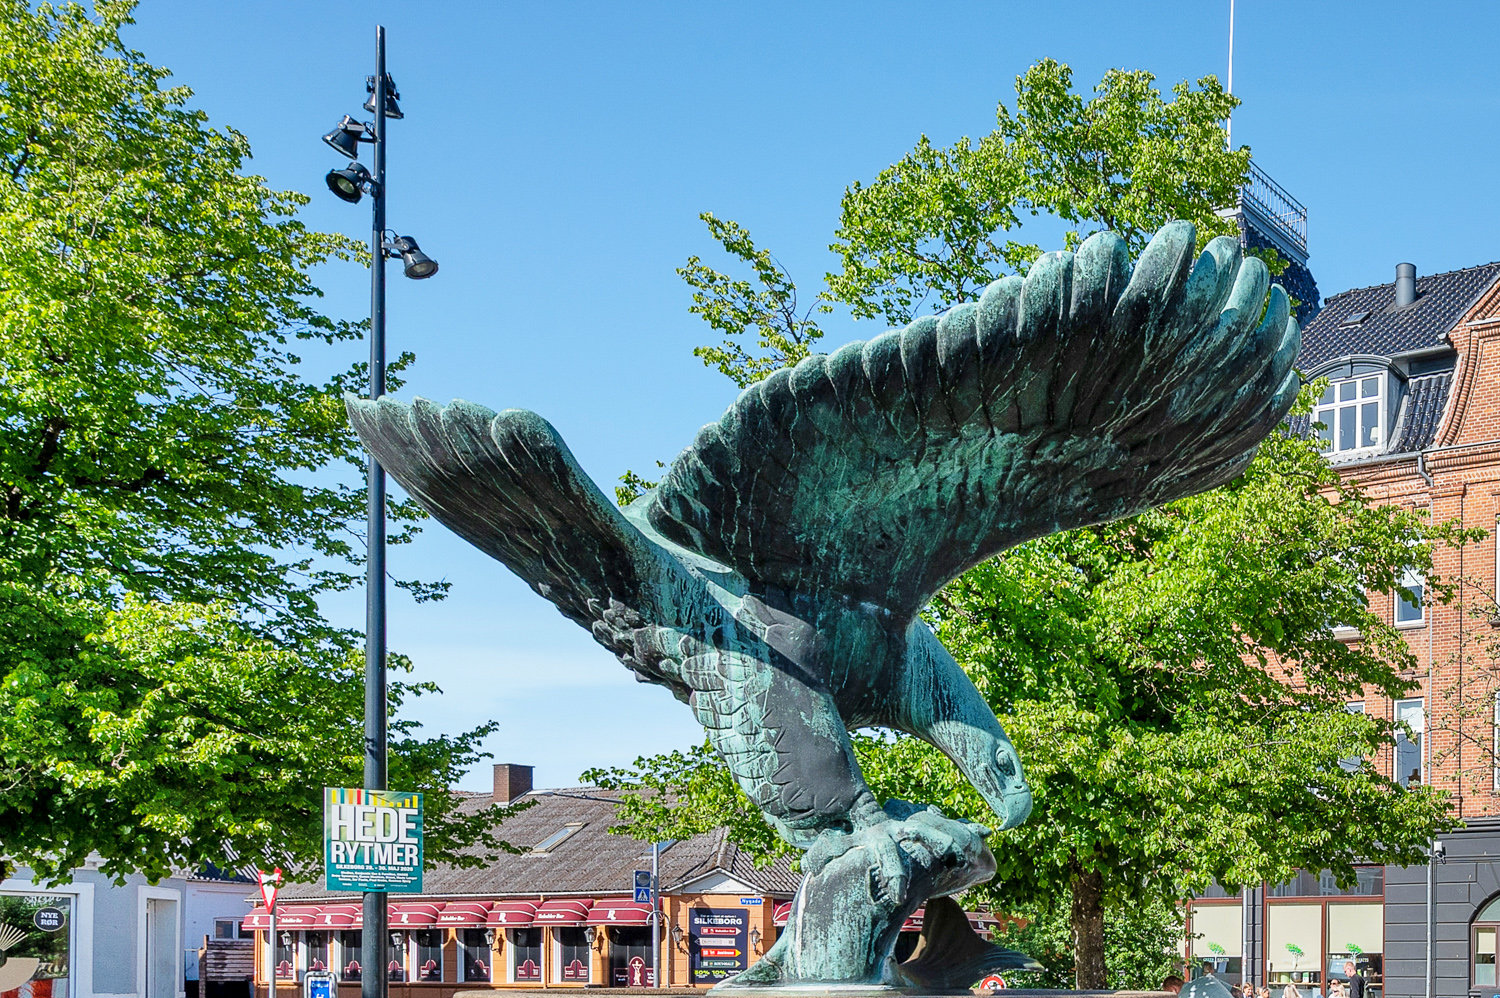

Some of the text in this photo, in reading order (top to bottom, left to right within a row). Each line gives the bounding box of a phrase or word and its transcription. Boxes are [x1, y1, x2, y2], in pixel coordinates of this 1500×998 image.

[331, 804, 418, 844] HEDE
[331, 841, 418, 866] RYTMER
[694, 917, 743, 925] SILKEBORG
